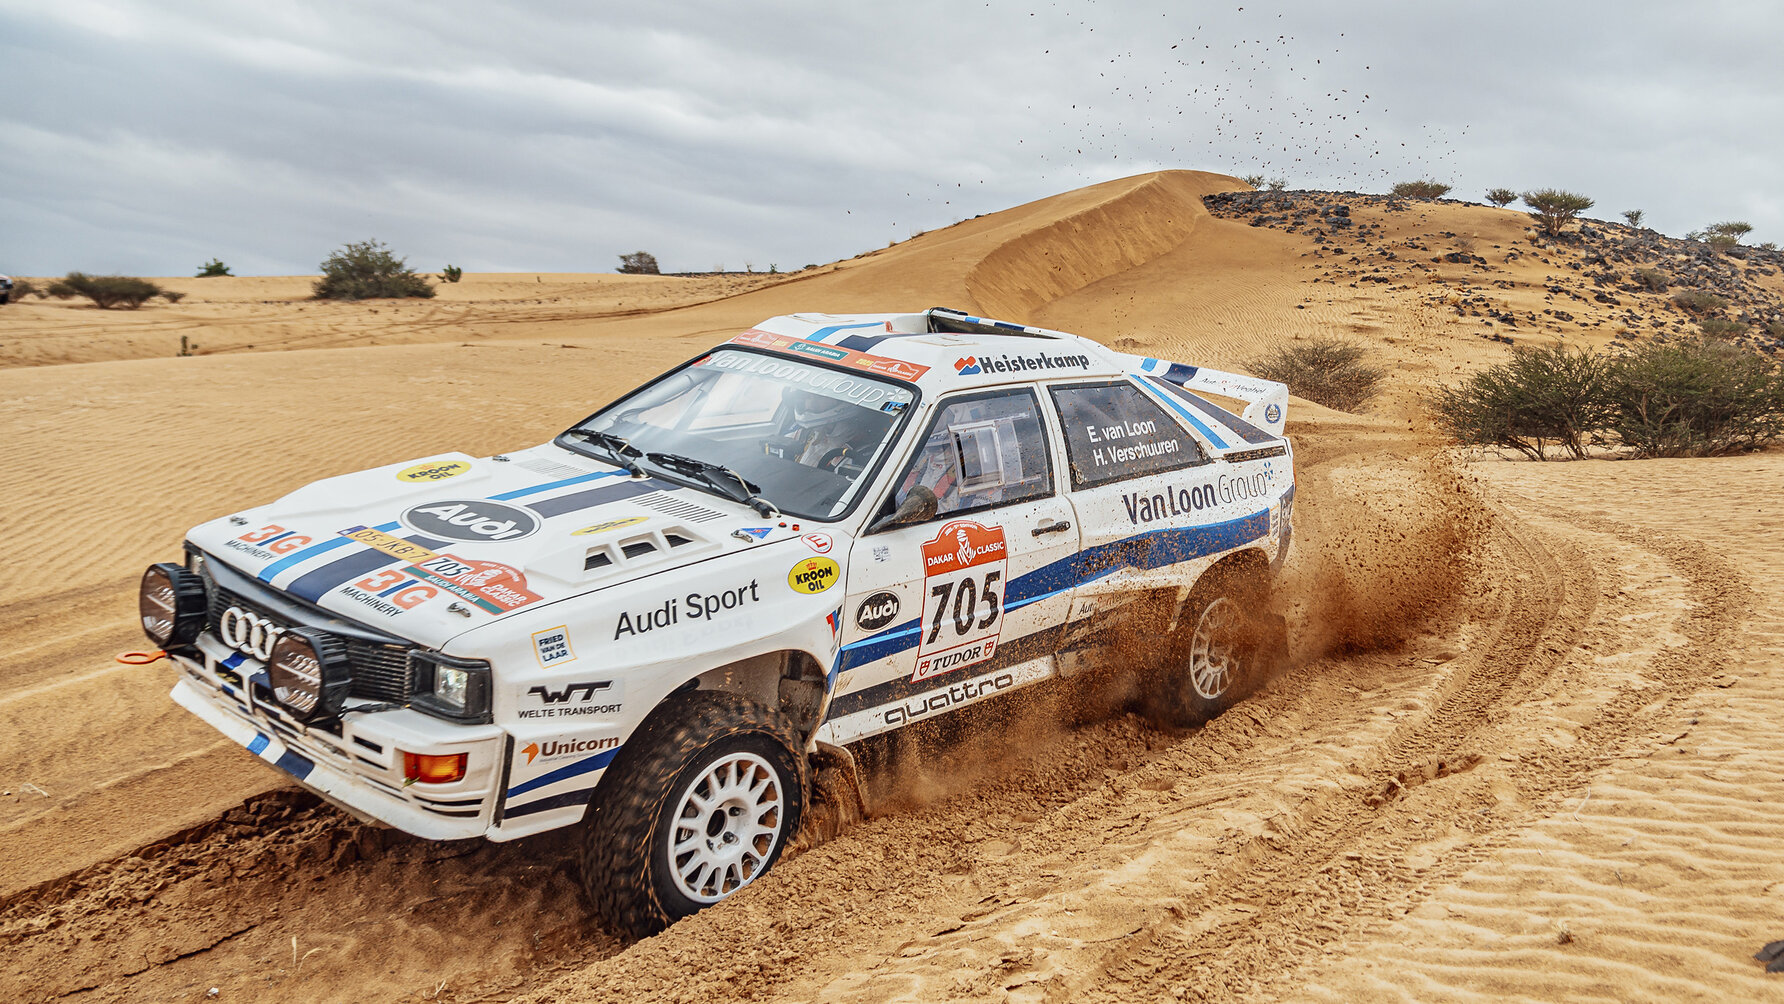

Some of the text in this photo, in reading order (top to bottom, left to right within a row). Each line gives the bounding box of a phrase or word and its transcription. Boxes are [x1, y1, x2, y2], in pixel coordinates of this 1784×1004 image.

[978, 352, 1090, 375] Heisterkamp
[1087, 418, 1156, 443] E. van Loon
[1093, 438, 1179, 467] H. Verschuuren
[407, 462, 461, 480] KROON
[429, 470, 454, 480] OIL
[414, 503, 523, 540] Audi
[224, 539, 278, 561] MACHINERY
[927, 541, 1005, 567] DAKAR CLASSIC
[423, 558, 472, 577] 705
[795, 566, 833, 585] KROON
[449, 584, 480, 602] ARABIA
[490, 583, 527, 602] DAKAR
[807, 580, 825, 591] OIL
[339, 585, 404, 618] MACHINERY
[614, 578, 760, 641] Audi Sport
[926, 570, 1001, 645] 705
[858, 601, 899, 626] Audi
[538, 633, 564, 647] FRIED
[541, 643, 566, 653] VAN DE
[542, 650, 568, 662] LAAR
[932, 645, 982, 672] TUDOR
[884, 672, 1014, 725] quattro
[518, 703, 622, 719] WELTE TRANSPORT
[541, 737, 620, 756] Unicorn
